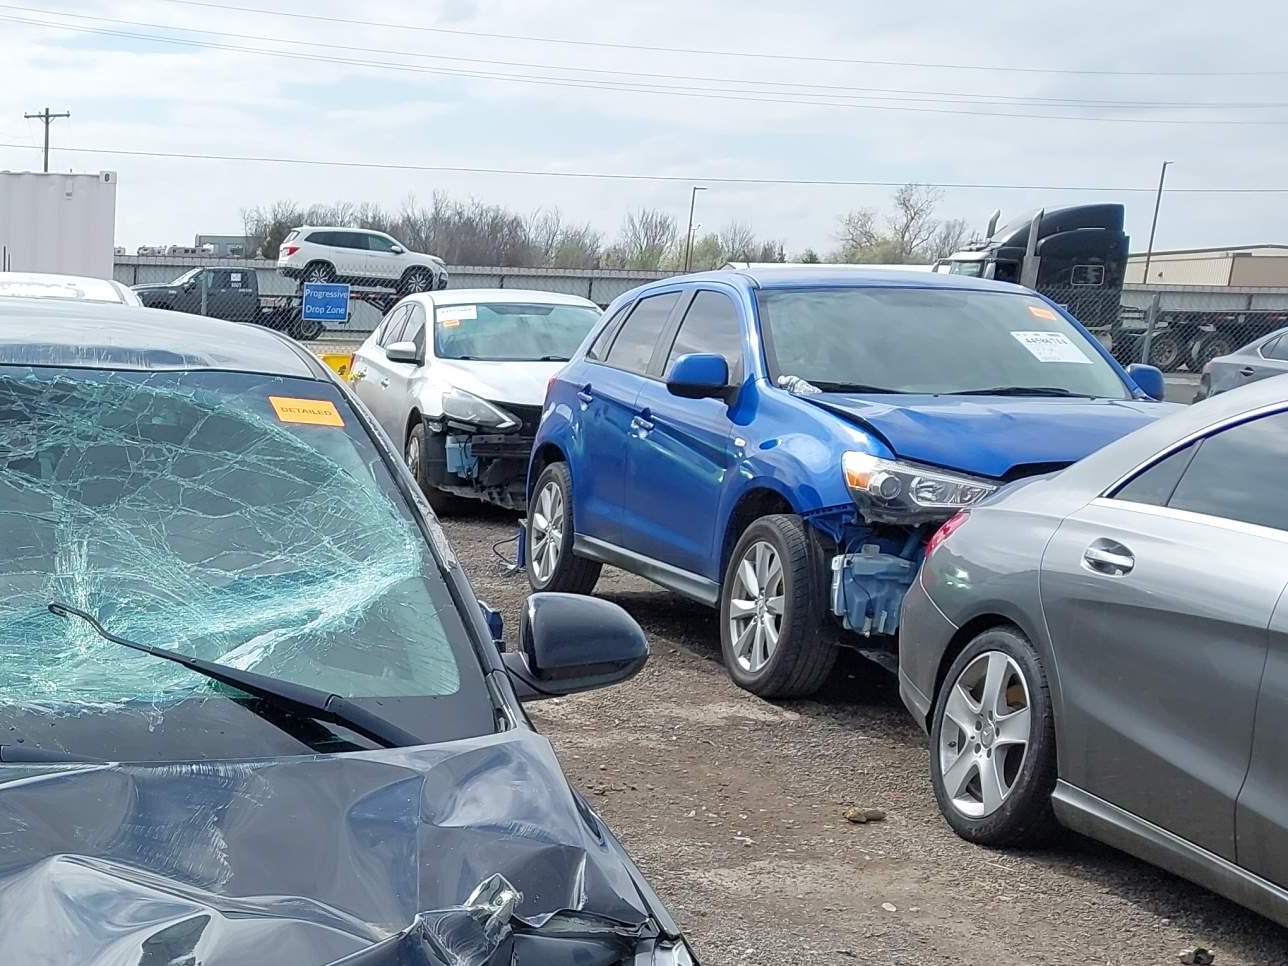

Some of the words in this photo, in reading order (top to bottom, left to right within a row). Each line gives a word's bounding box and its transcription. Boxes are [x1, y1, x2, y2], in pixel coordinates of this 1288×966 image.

[305, 289, 348, 299] Progressive
[306, 305, 325, 315] Drop
[326, 305, 345, 314] Zone
[280, 407, 333, 416] DETAILED
